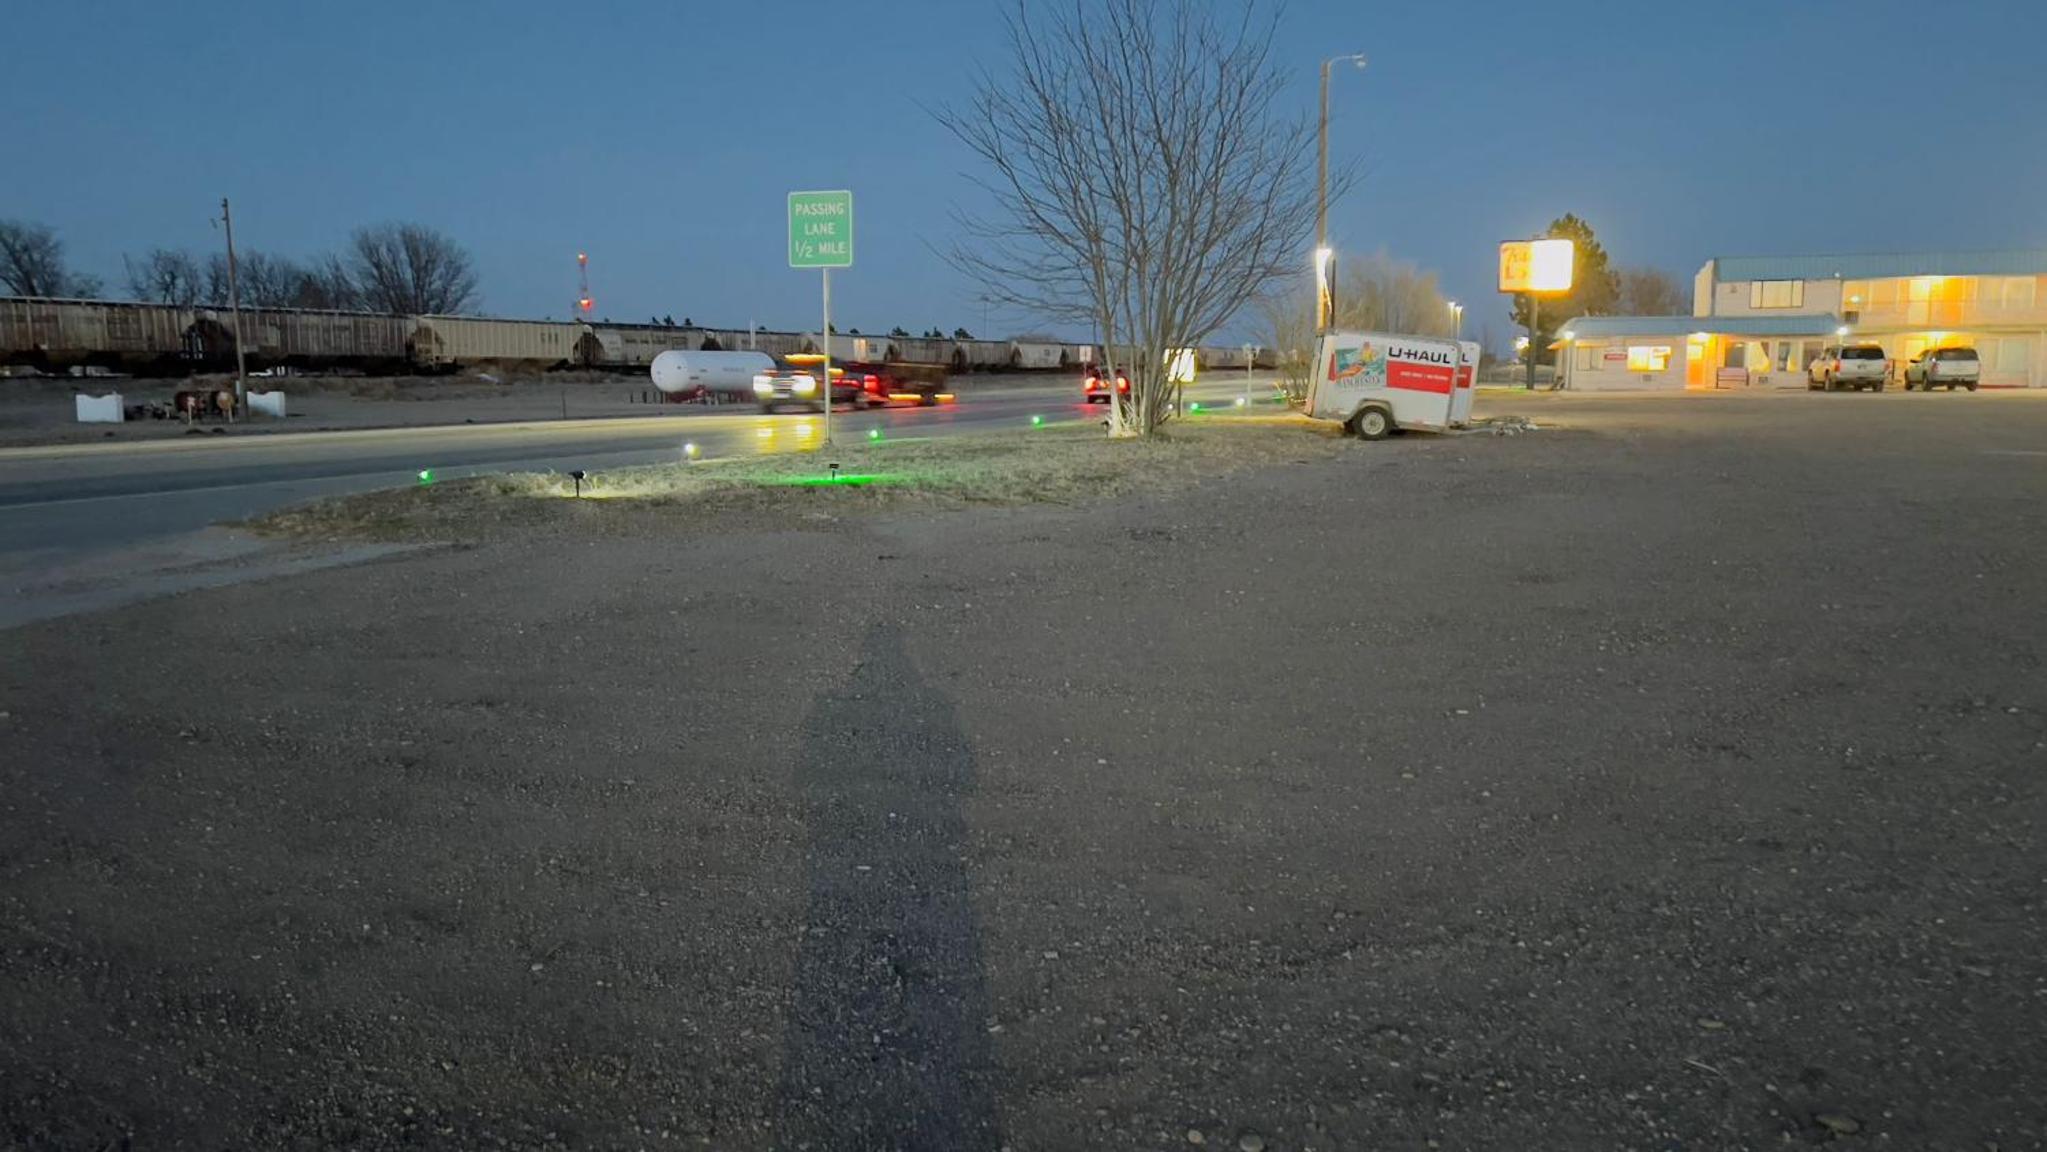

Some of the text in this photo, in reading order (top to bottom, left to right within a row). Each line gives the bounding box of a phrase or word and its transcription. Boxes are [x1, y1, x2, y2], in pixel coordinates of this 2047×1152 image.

[795, 203, 844, 216] PASSING
[805, 222, 836, 235] LANE
[795, 240, 847, 258] 1/2 MILE
[1388, 345, 1451, 364] U-HAUL
